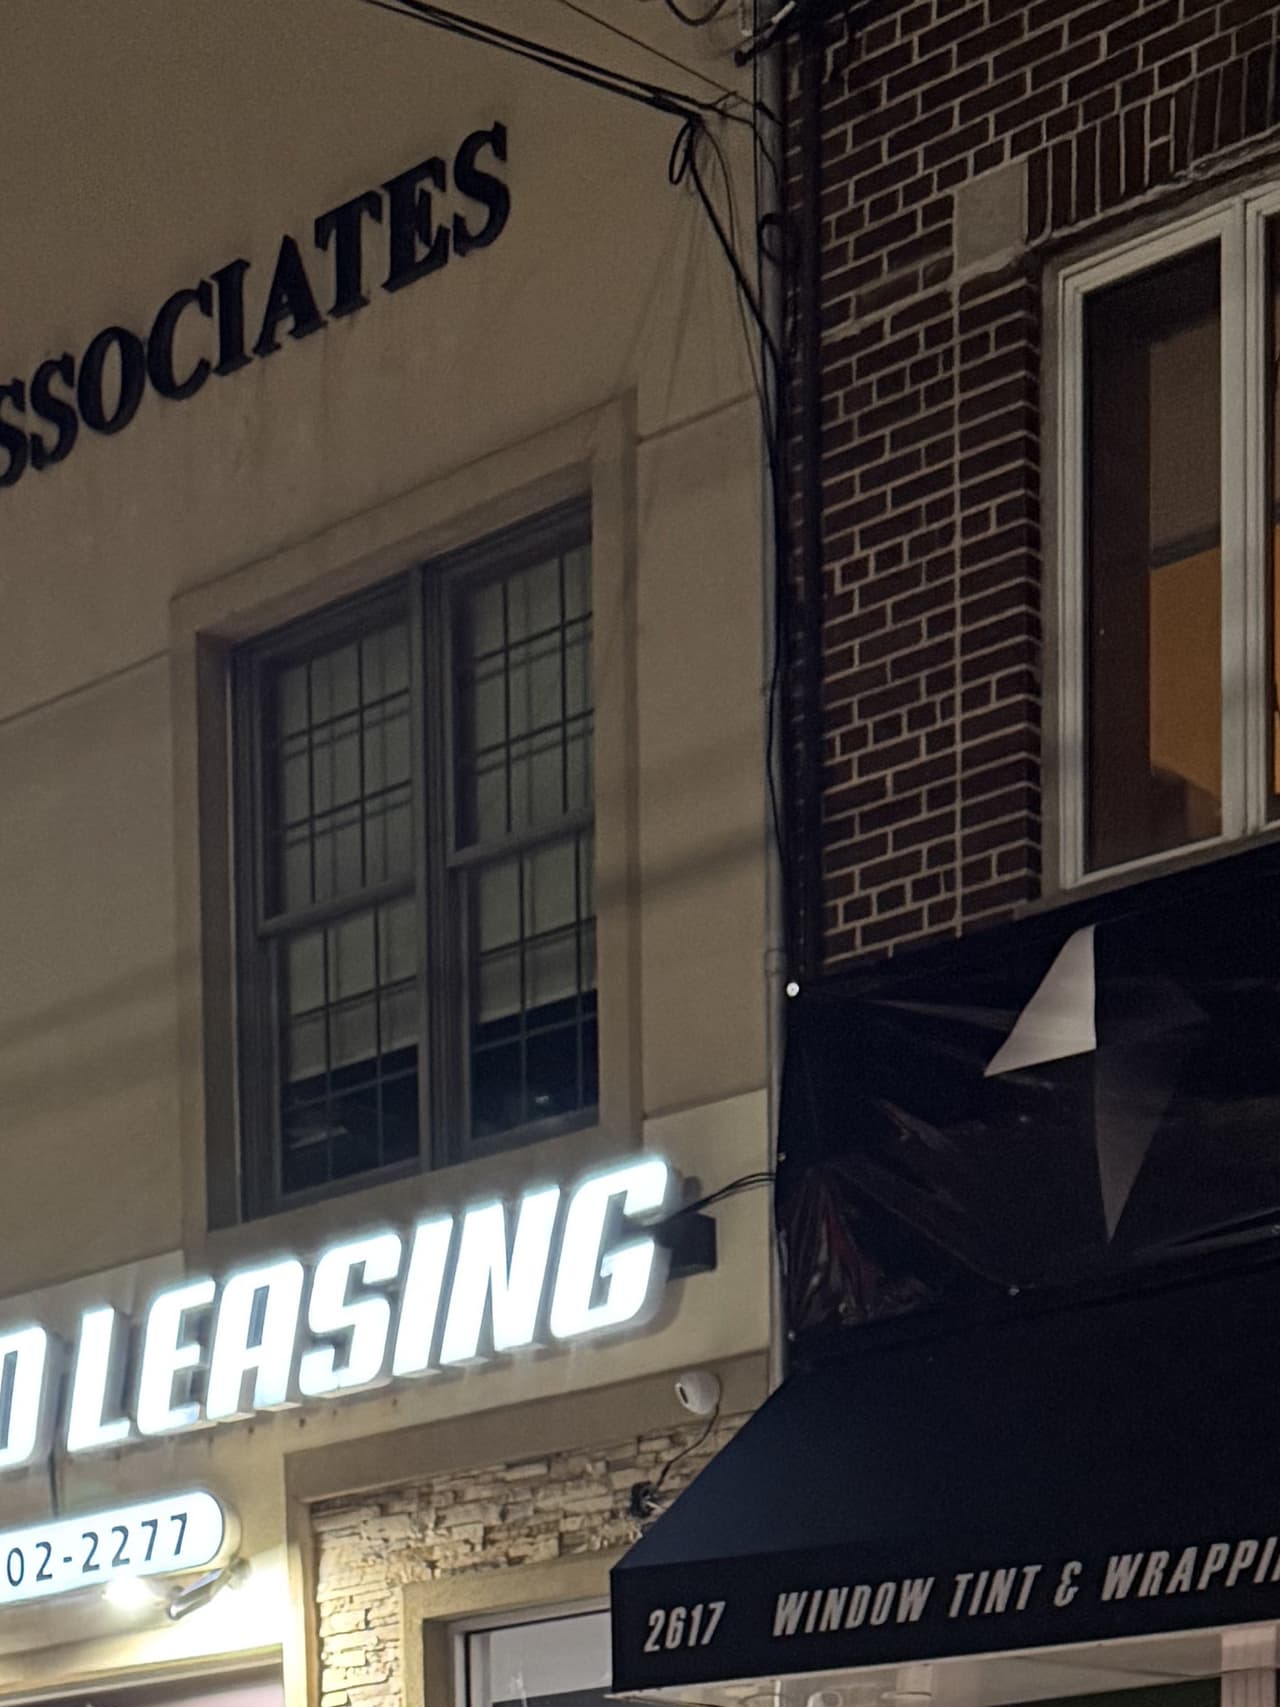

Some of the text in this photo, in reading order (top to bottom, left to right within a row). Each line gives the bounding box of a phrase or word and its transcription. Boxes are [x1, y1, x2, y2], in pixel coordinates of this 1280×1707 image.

[66, 1156, 670, 1455] LEASING
[643, 1601, 725, 1654] 2617
[773, 1576, 934, 1638] WINDOW
[948, 1563, 1038, 1619] TINT
[1054, 1560, 1082, 1608] &
